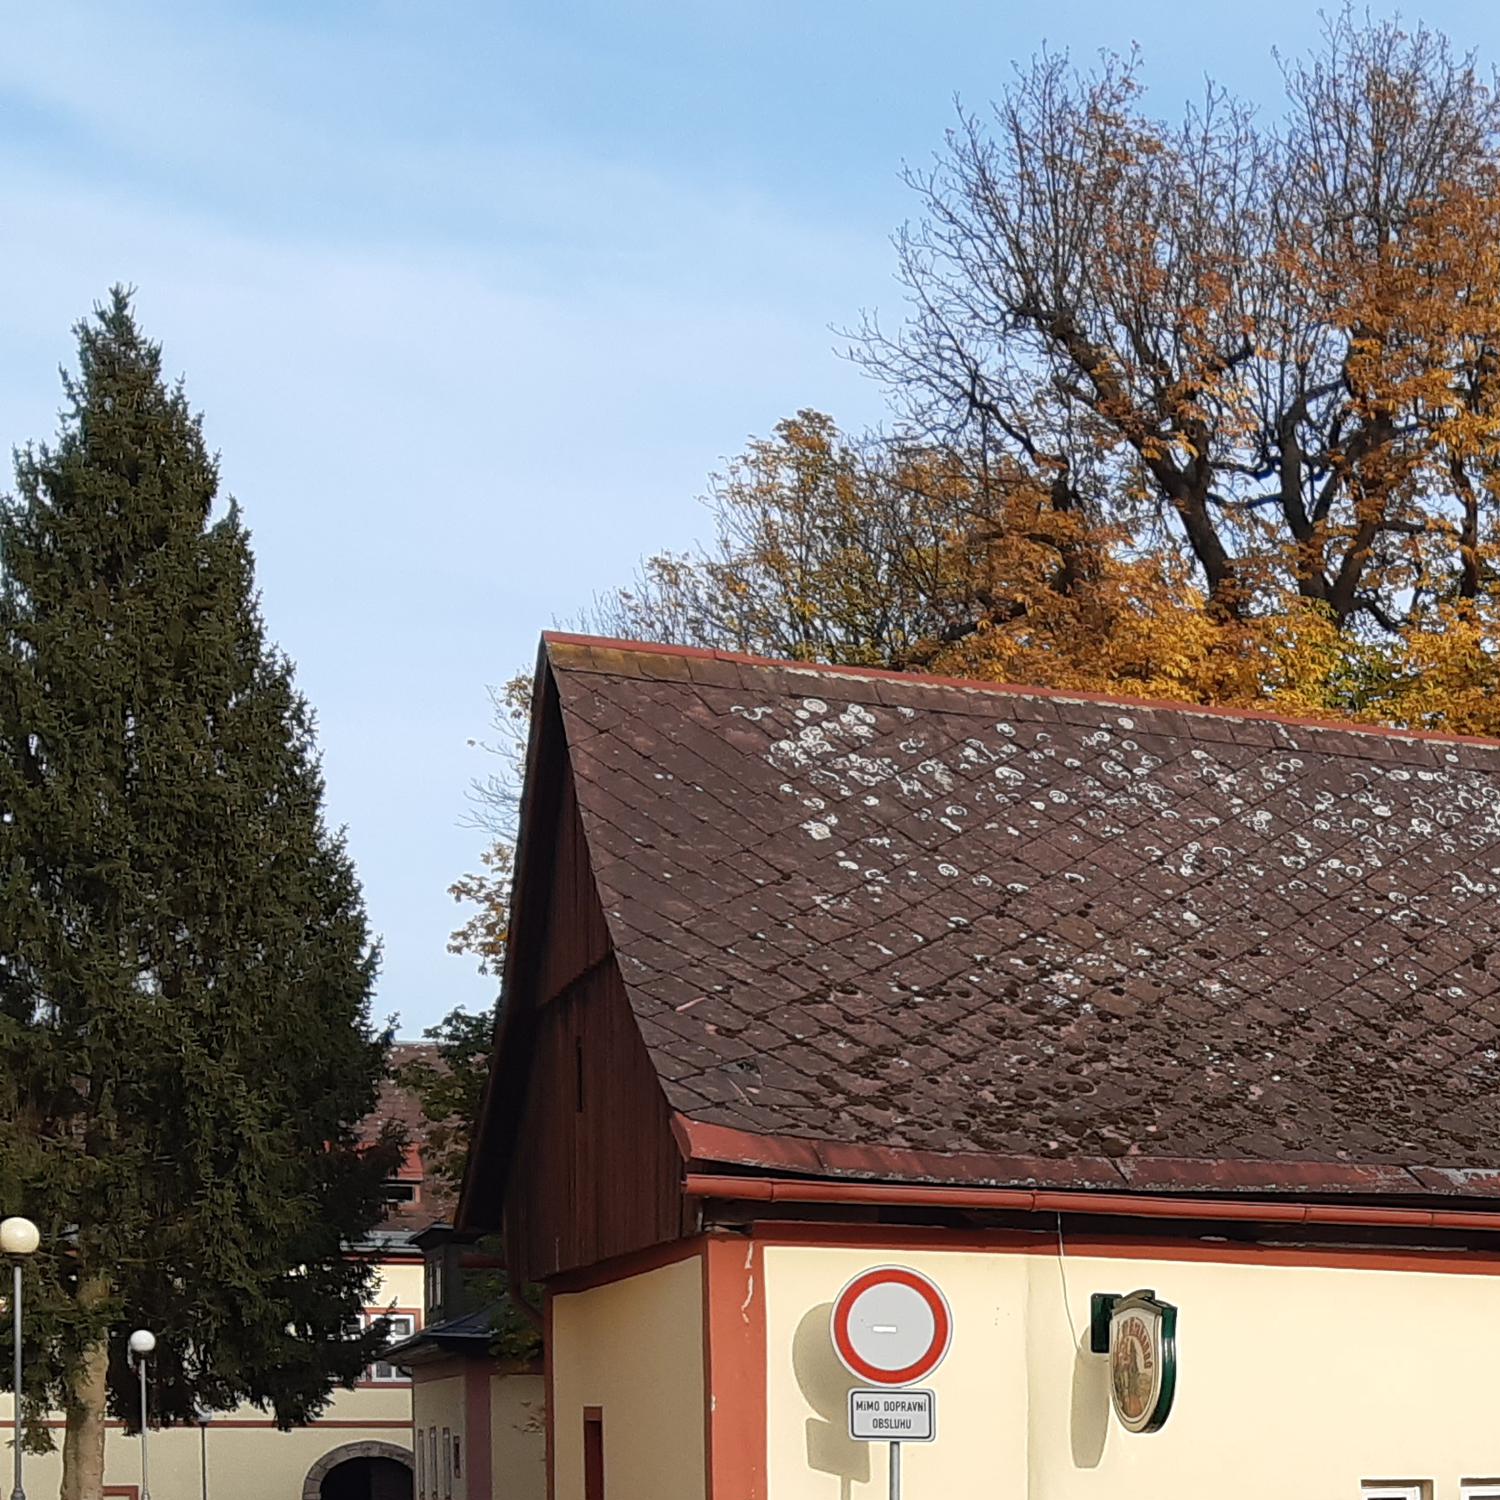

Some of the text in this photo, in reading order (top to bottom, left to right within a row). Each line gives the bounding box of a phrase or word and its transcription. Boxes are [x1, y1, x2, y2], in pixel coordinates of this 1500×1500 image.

[856, 1399, 927, 1412] MIMO DOPRAVNÍ
[872, 1418, 912, 1429] OBSLUHU
